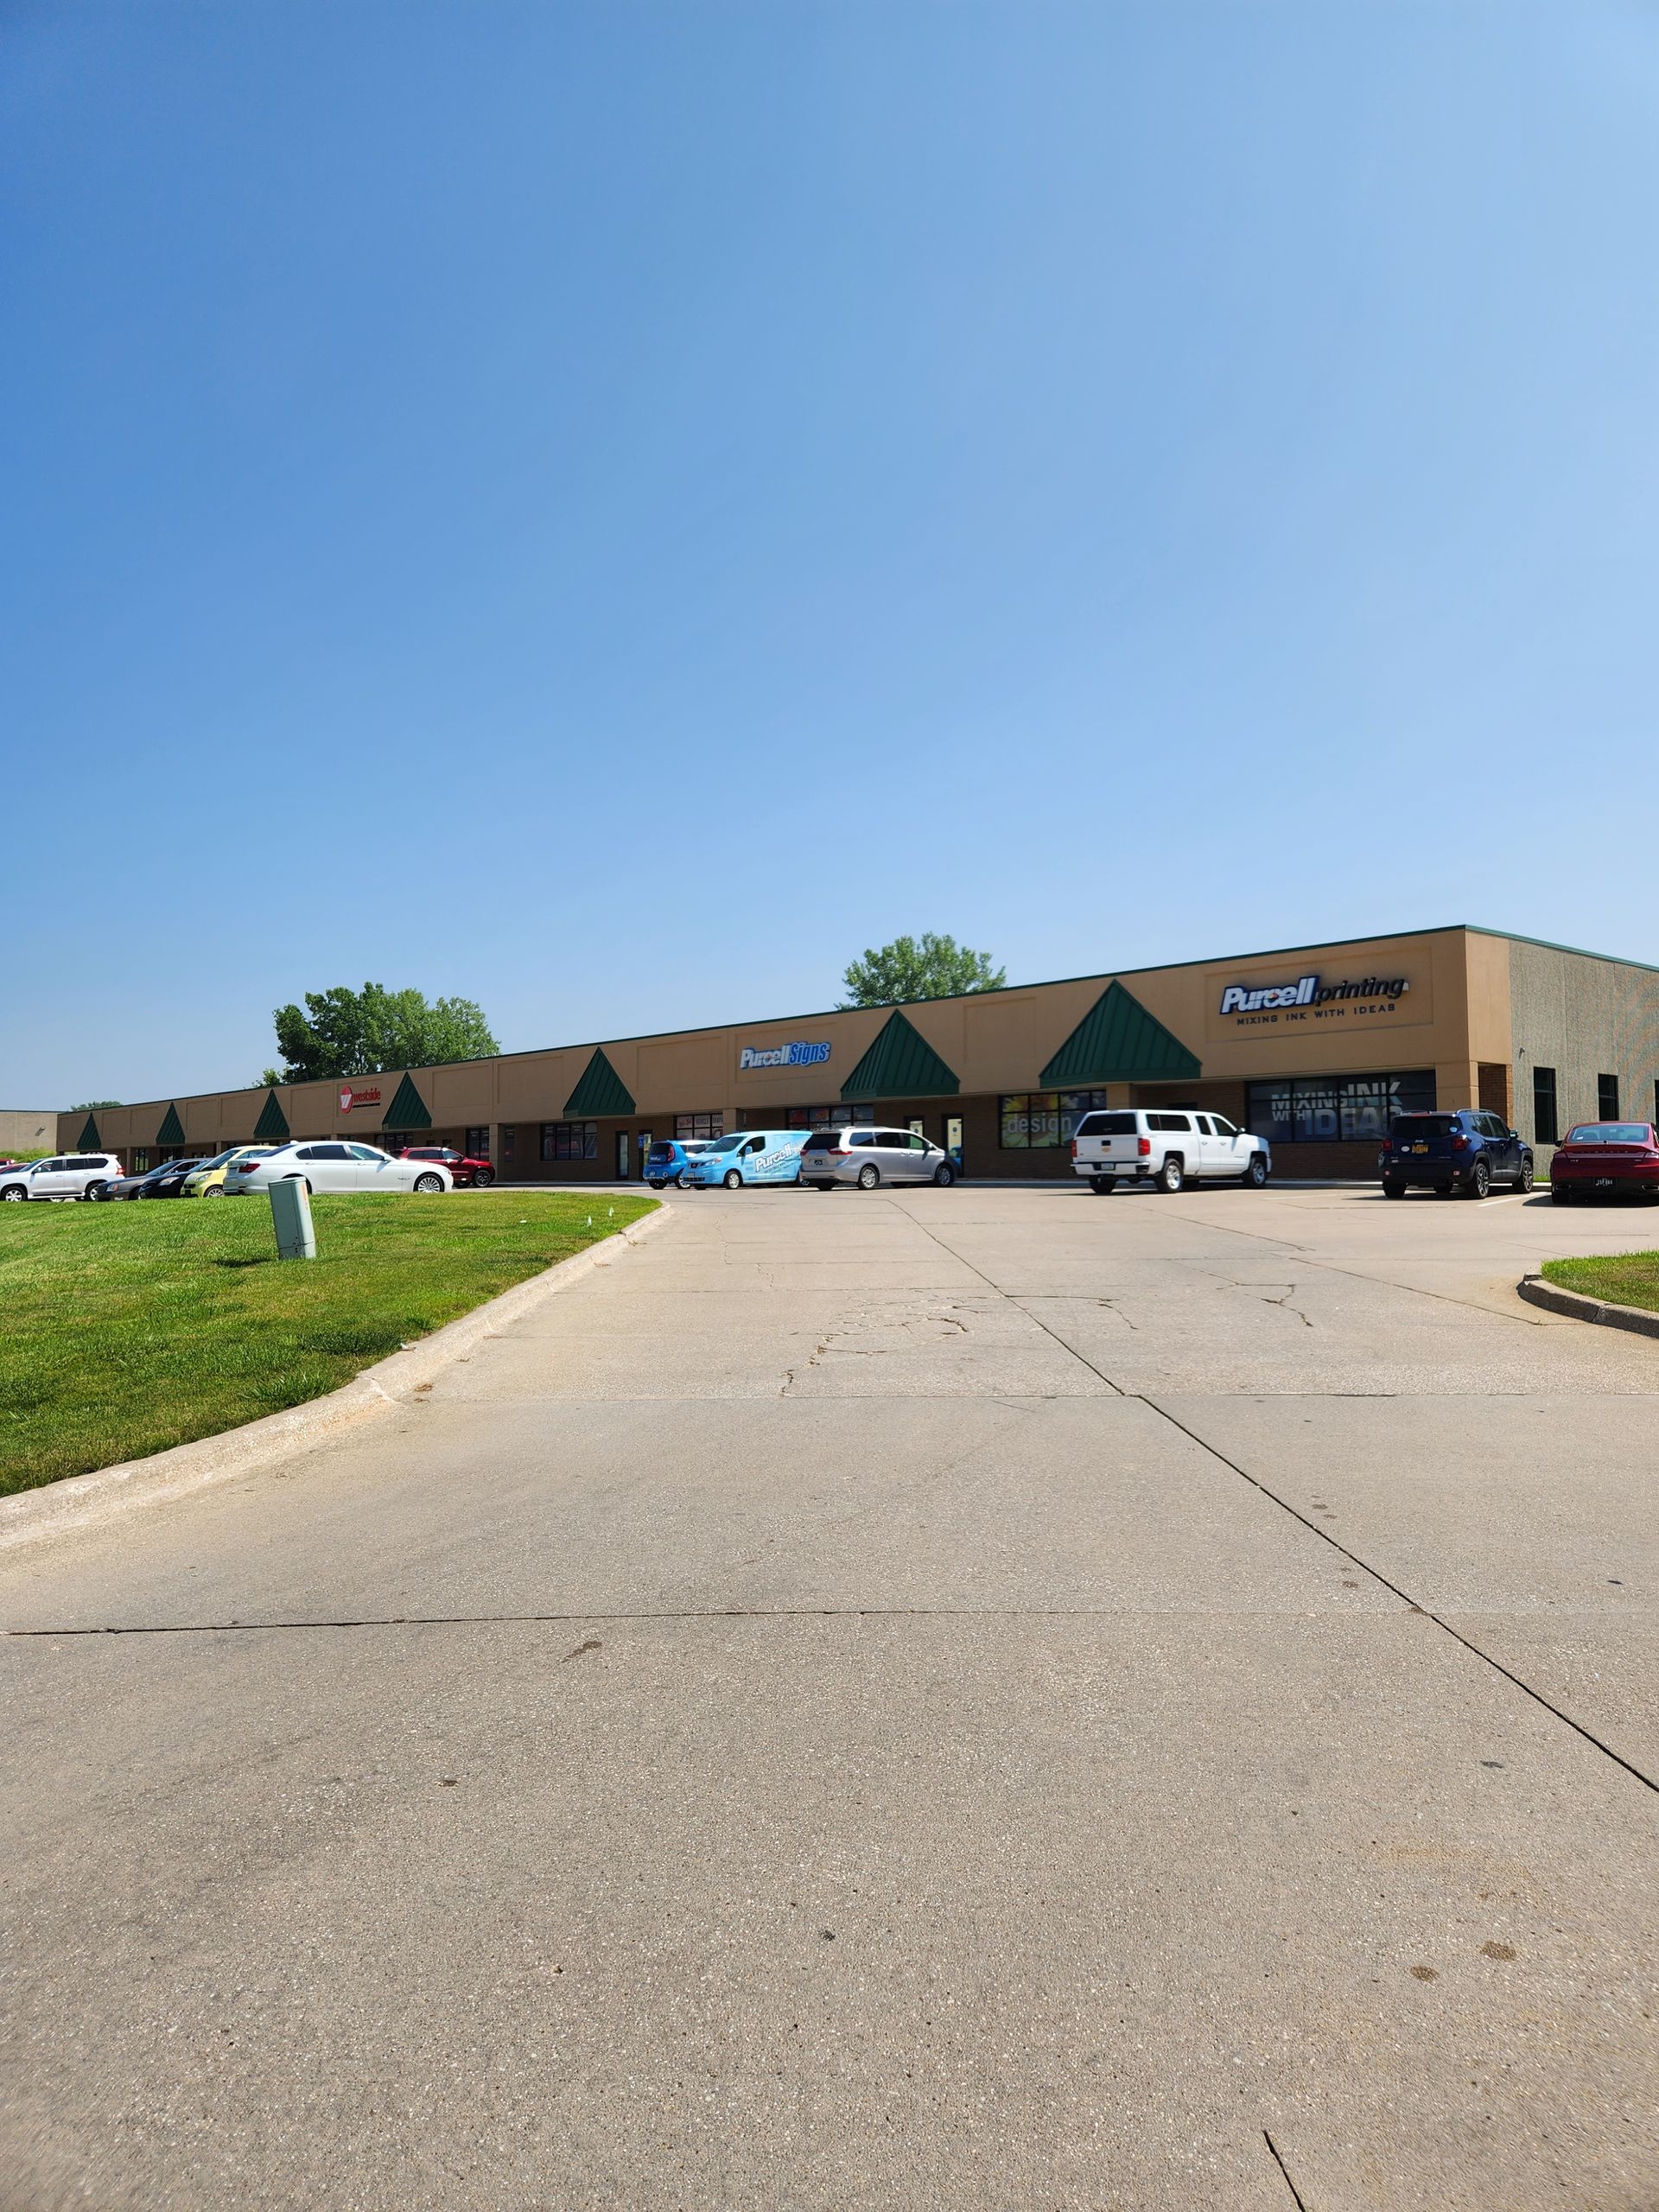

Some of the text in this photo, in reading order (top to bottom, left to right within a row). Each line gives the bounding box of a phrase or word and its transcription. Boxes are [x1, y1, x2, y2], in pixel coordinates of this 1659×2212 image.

[1221, 976, 1405, 1014] Purcell printing
[1237, 1003, 1395, 1026] MIXING INK WITH IDEAS
[1272, 1082, 1402, 1110] MIXING INK
[1007, 1112, 1071, 1137] design
[754, 1142, 792, 1173] Purcell
